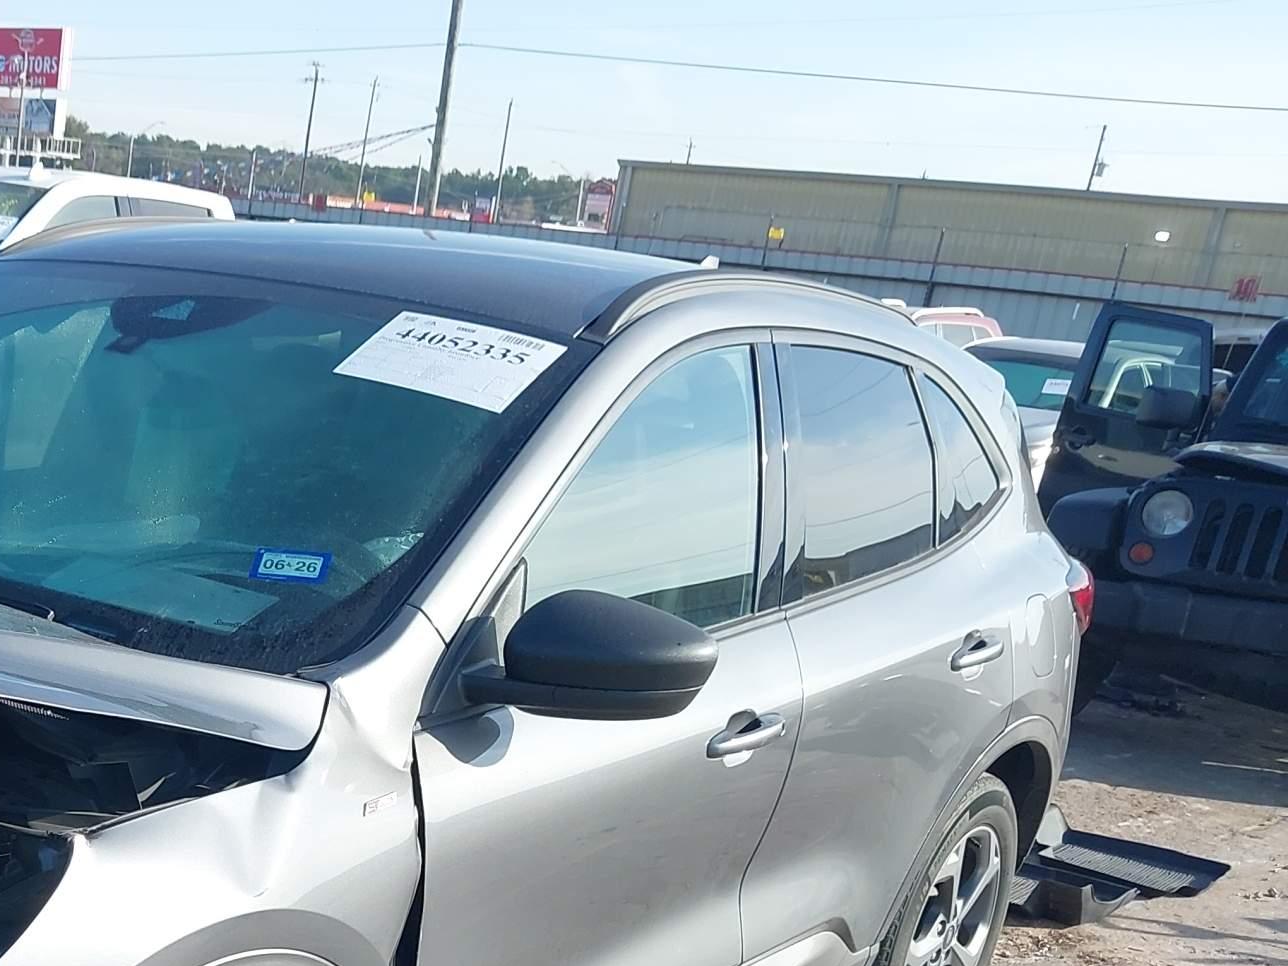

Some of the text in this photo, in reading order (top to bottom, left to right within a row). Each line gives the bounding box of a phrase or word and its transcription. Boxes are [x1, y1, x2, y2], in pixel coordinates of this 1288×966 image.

[396, 327, 531, 365] 44052335
[263, 558, 318, 573] 06 26
